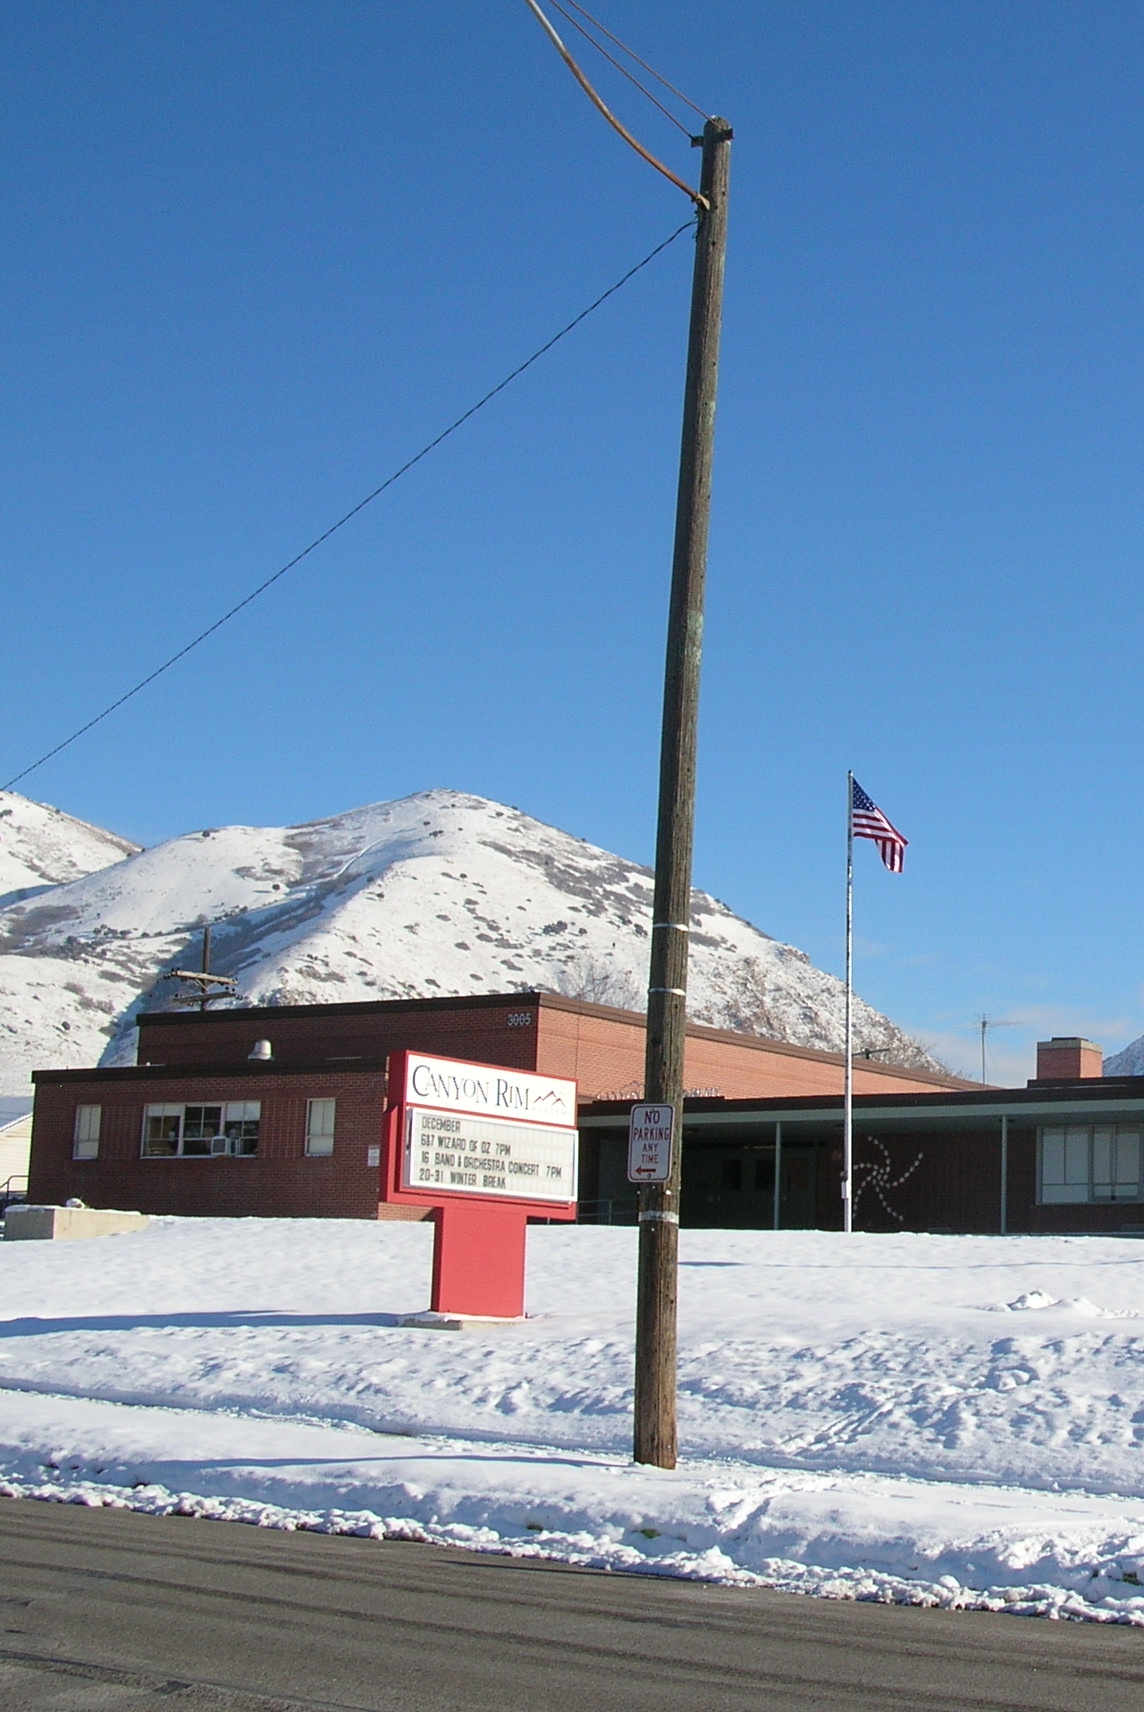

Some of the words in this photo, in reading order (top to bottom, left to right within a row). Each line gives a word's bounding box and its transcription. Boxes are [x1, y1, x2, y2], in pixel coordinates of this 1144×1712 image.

[508, 1013, 531, 1026] 3005
[412, 1065, 489, 1104] CANYON
[496, 1078, 529, 1110] RIM
[422, 1117, 460, 1132] DECEMBER
[645, 1111, 660, 1124] NO
[633, 1127, 669, 1141] PARKING
[438, 1136, 466, 1151] WIZARD
[469, 1140, 478, 1152] OF
[481, 1142, 490, 1154] OZ
[496, 1143, 511, 1156] 7PM
[643, 1143, 658, 1152] ANY
[422, 1151, 429, 1163] 16
[435, 1152, 455, 1165] BAND
[457, 1155, 461, 1167] &
[464, 1156, 505, 1172] ORCHESTRA
[509, 1161, 539, 1176] CONCERT
[546, 1166, 561, 1178] 7PM
[641, 1154, 659, 1164] TIME
[419, 1168, 443, 1182] 20-31
[451, 1172, 476, 1186] WINTER
[483, 1176, 506, 1188] BREAK
